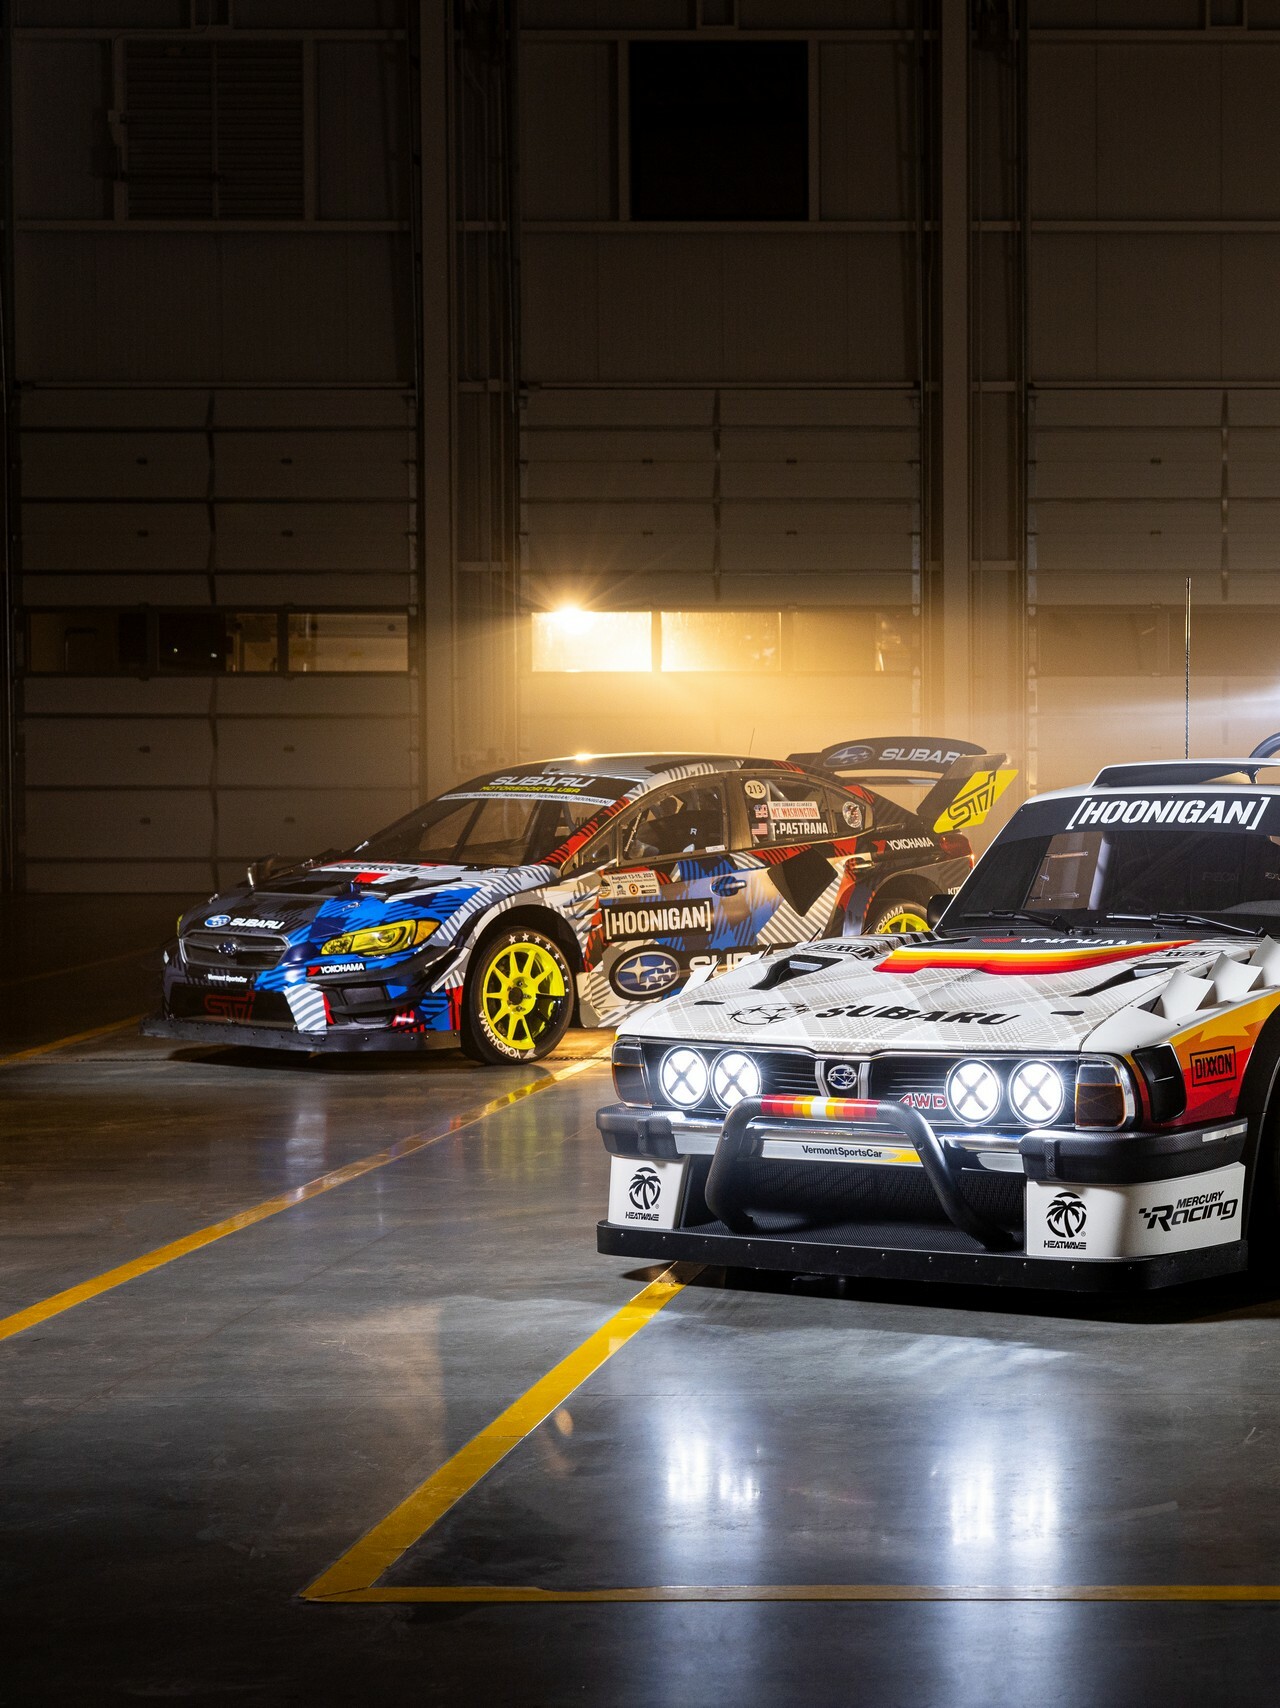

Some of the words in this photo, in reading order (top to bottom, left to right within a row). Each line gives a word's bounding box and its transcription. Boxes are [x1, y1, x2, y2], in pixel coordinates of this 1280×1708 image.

[879, 748, 967, 765] SUBAR
[480, 785, 557, 793] MOTORSPORTS
[489, 776, 596, 788] SUBARU
[747, 784, 763, 794] 213
[782, 808, 819, 818] WASHINGTON
[1065, 797, 1271, 830] [HOONIGAN]
[887, 837, 934, 851] YOKOHAMA
[230, 917, 285, 930] SUBARU
[604, 901, 711, 940] [HOONIGAN]
[320, 963, 365, 974] YOKOHAMA
[815, 1005, 1021, 1025] SUBARU
[478, 1010, 521, 1059] YOKOHAMA
[1195, 1053, 1233, 1079] DIXXON
[900, 1093, 947, 1110] 4WD
[1176, 1190, 1225, 1209] MERCURY
[625, 1211, 660, 1222] HEATWAVE
[1143, 1198, 1239, 1232] Racing
[1043, 1240, 1087, 1250] HEATWAVE
